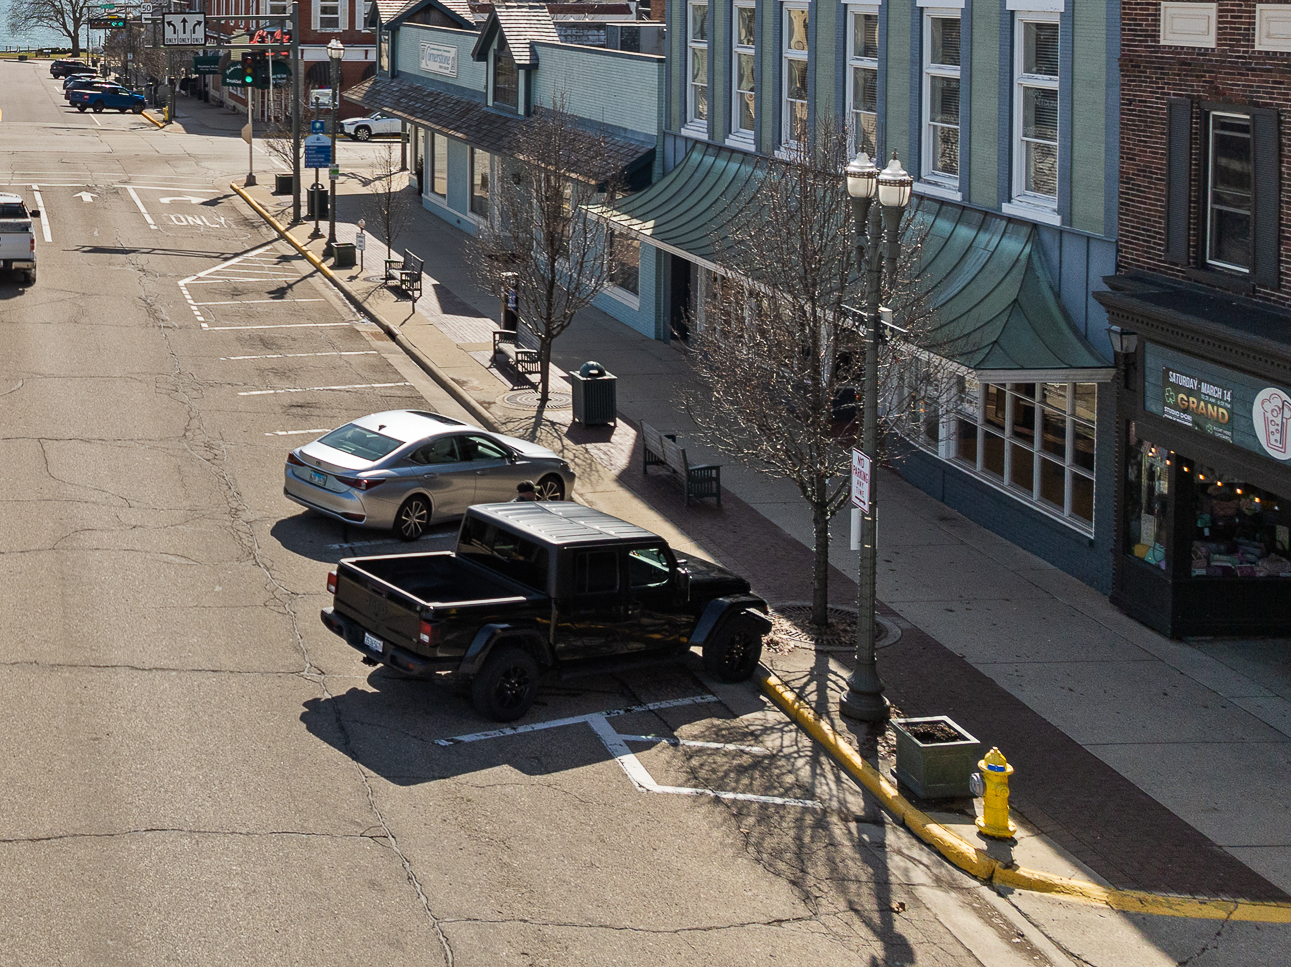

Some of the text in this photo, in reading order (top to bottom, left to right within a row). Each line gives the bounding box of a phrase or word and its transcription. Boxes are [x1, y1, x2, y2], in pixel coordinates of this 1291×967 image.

[169, 213, 227, 228] ONLY
[1169, 371, 1231, 402] SATURDAY MARCH 14
[1177, 393, 1229, 424] GRAND
[858, 455, 865, 468] NO
[853, 465, 868, 483] PARKING
[856, 486, 865, 498] TIME
